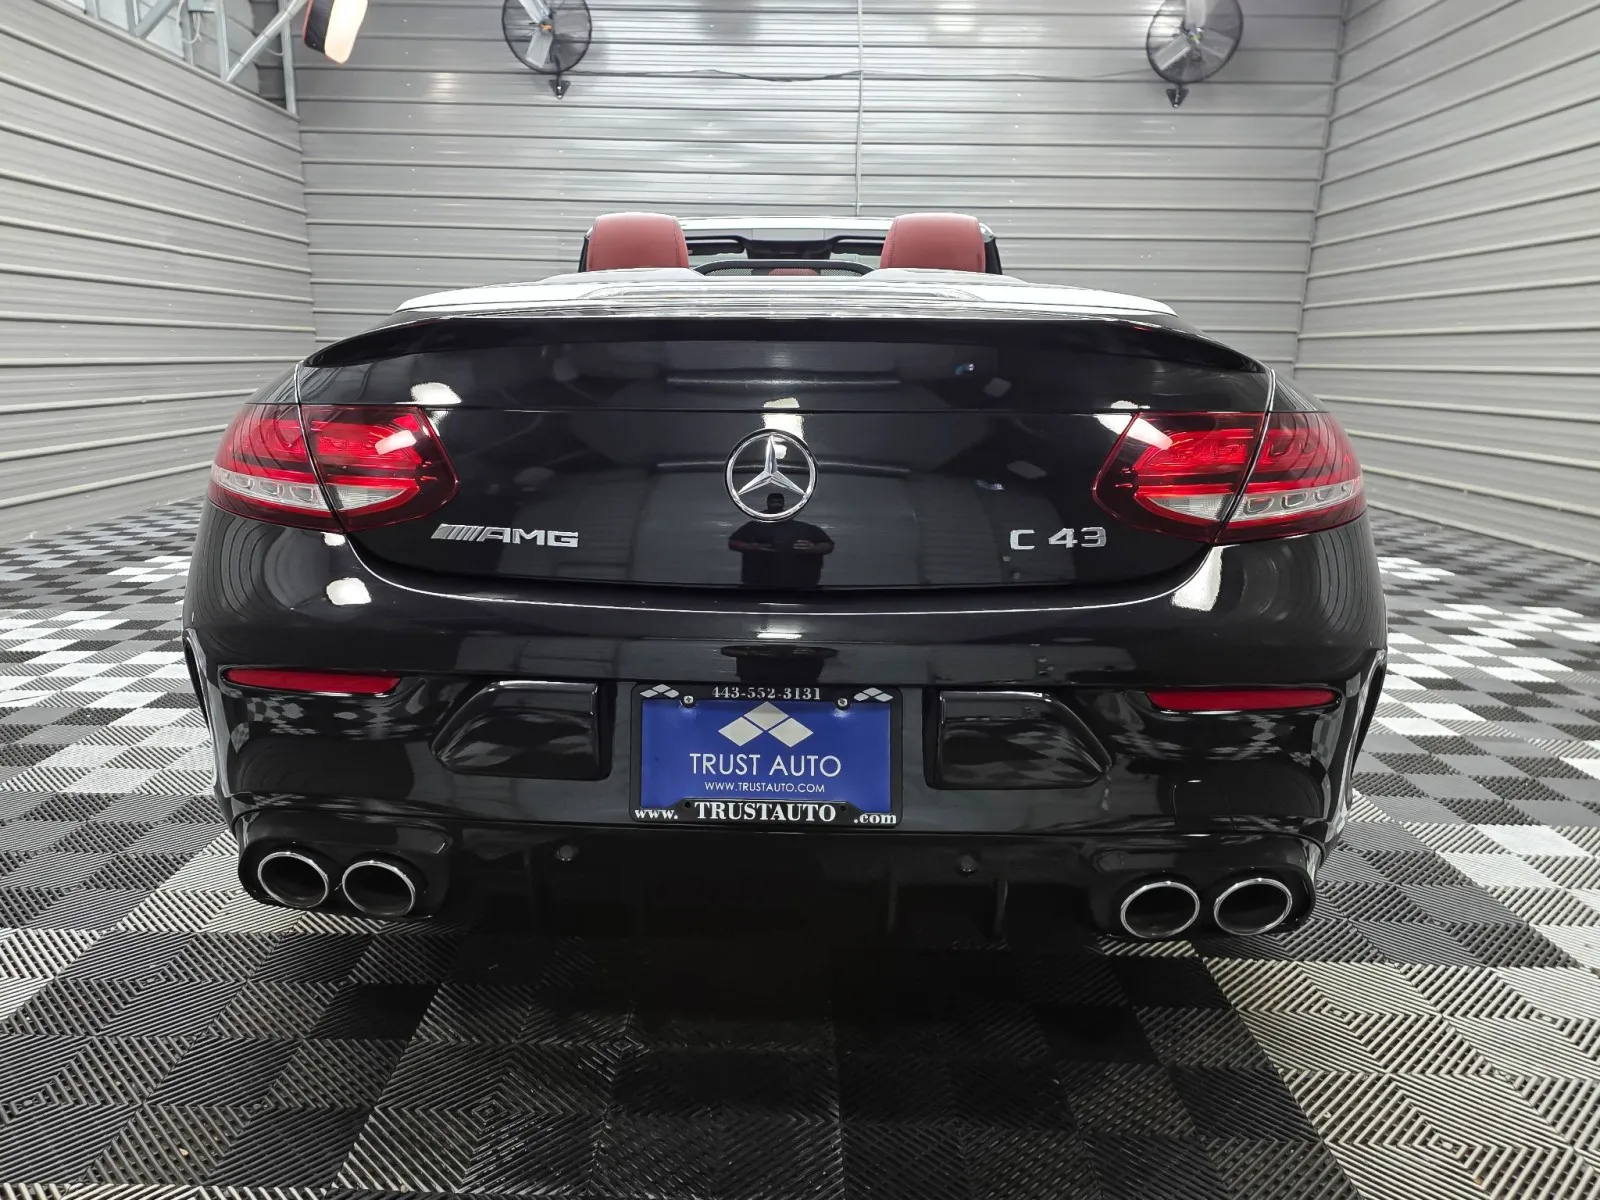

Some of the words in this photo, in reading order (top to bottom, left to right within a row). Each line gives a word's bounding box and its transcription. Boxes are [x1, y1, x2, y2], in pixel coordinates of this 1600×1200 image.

[476, 526, 579, 548] AMG
[1010, 529, 1035, 550] C
[1048, 526, 1107, 549] 43
[711, 686, 821, 700] 443-552-3131
[689, 753, 761, 775] TRUST
[769, 755, 842, 777] AUTO
[704, 781, 825, 793] WWW.TRUSTAUTO.COM
[634, 809, 679, 820] www.
[694, 801, 836, 822] TRUSTAUTO
[853, 812, 897, 824] .com
